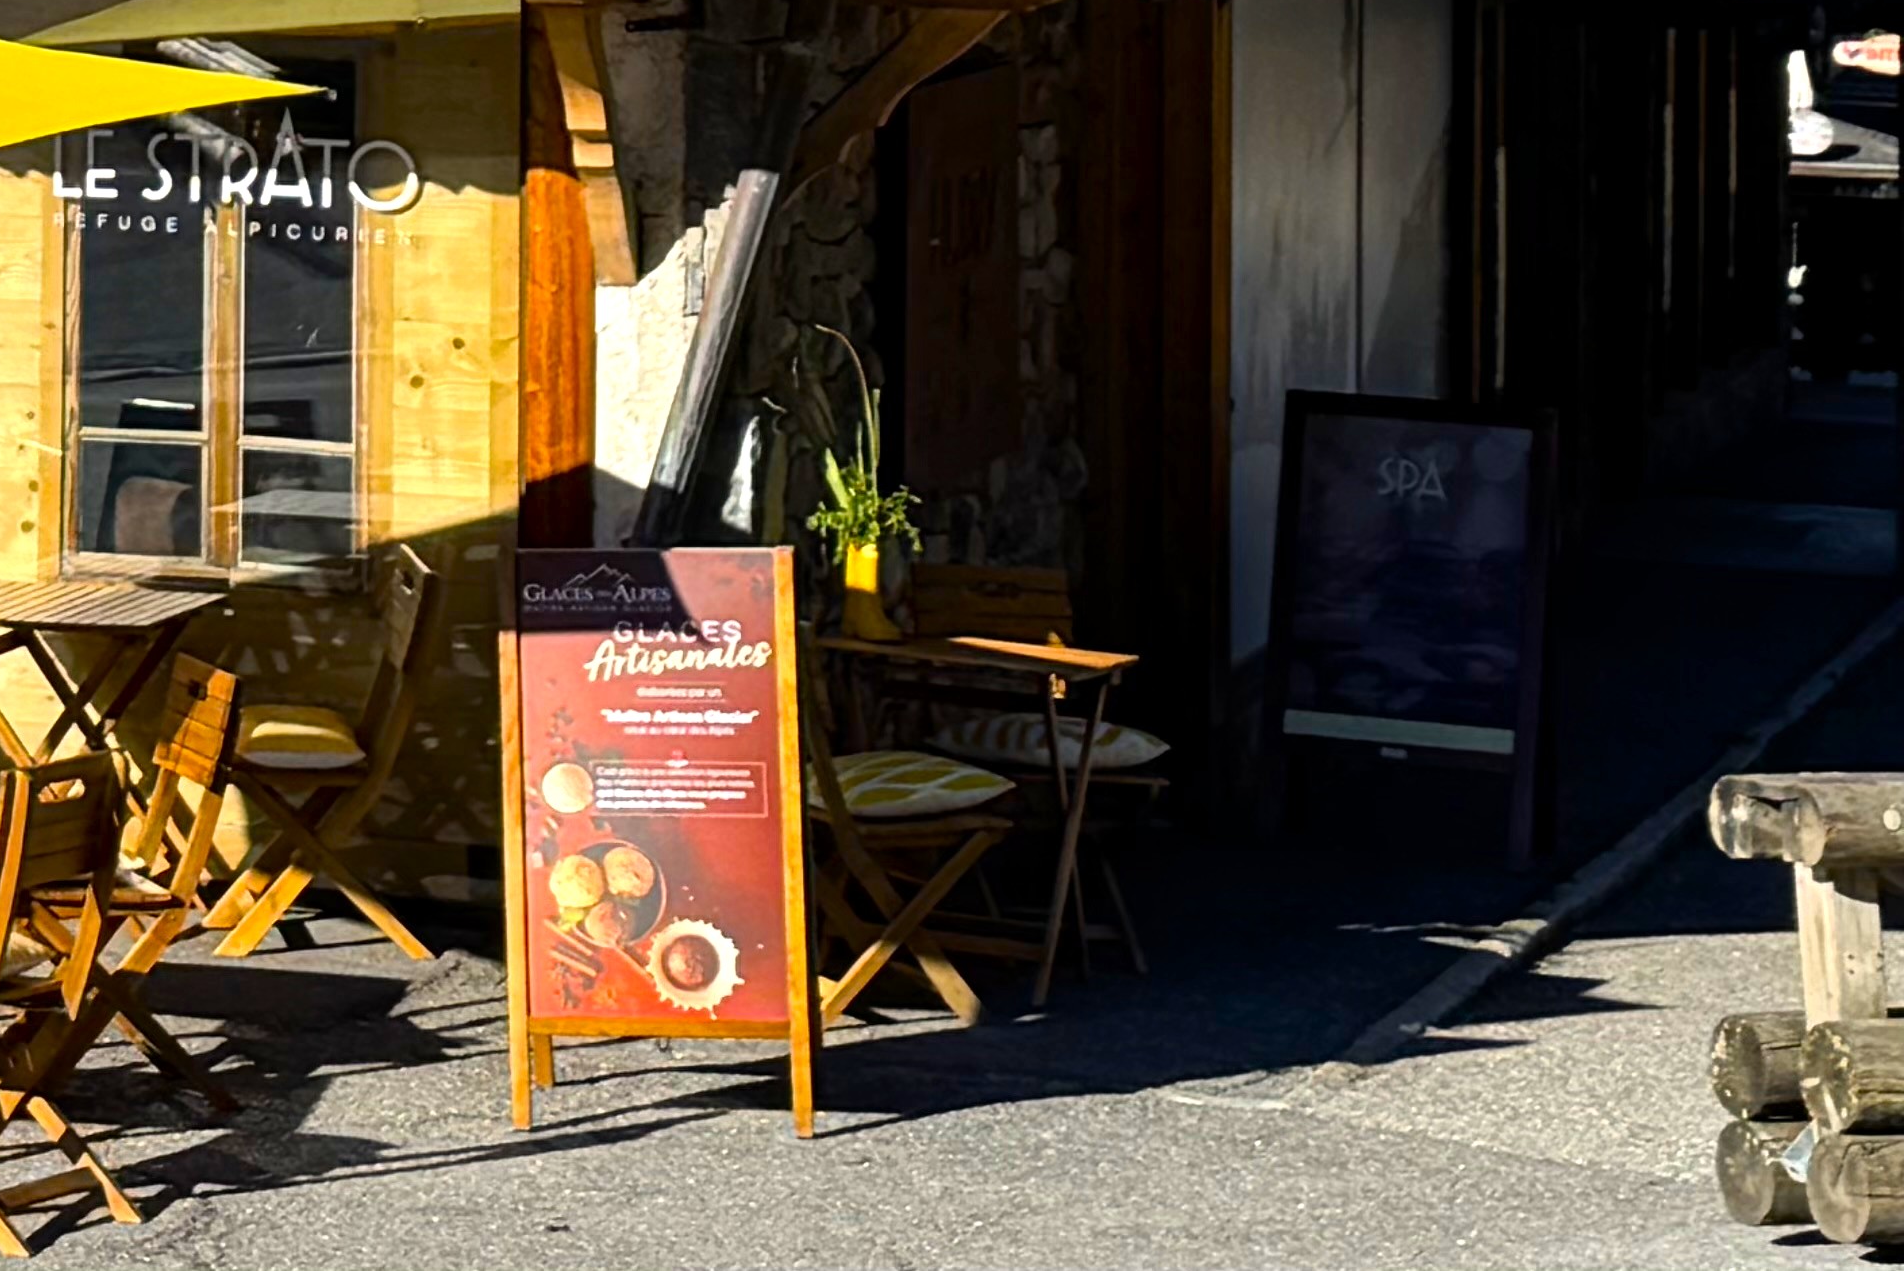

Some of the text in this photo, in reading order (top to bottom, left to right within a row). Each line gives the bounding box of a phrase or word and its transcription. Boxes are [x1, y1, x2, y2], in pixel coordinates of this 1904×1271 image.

[52, 107, 420, 213] LE STRATO
[54, 213, 179, 233] REFUGE
[1378, 457, 1446, 501] SPA
[612, 583, 672, 604] ALPES
[612, 619, 742, 643] GLACES
[583, 637, 773, 682] Artisanales
